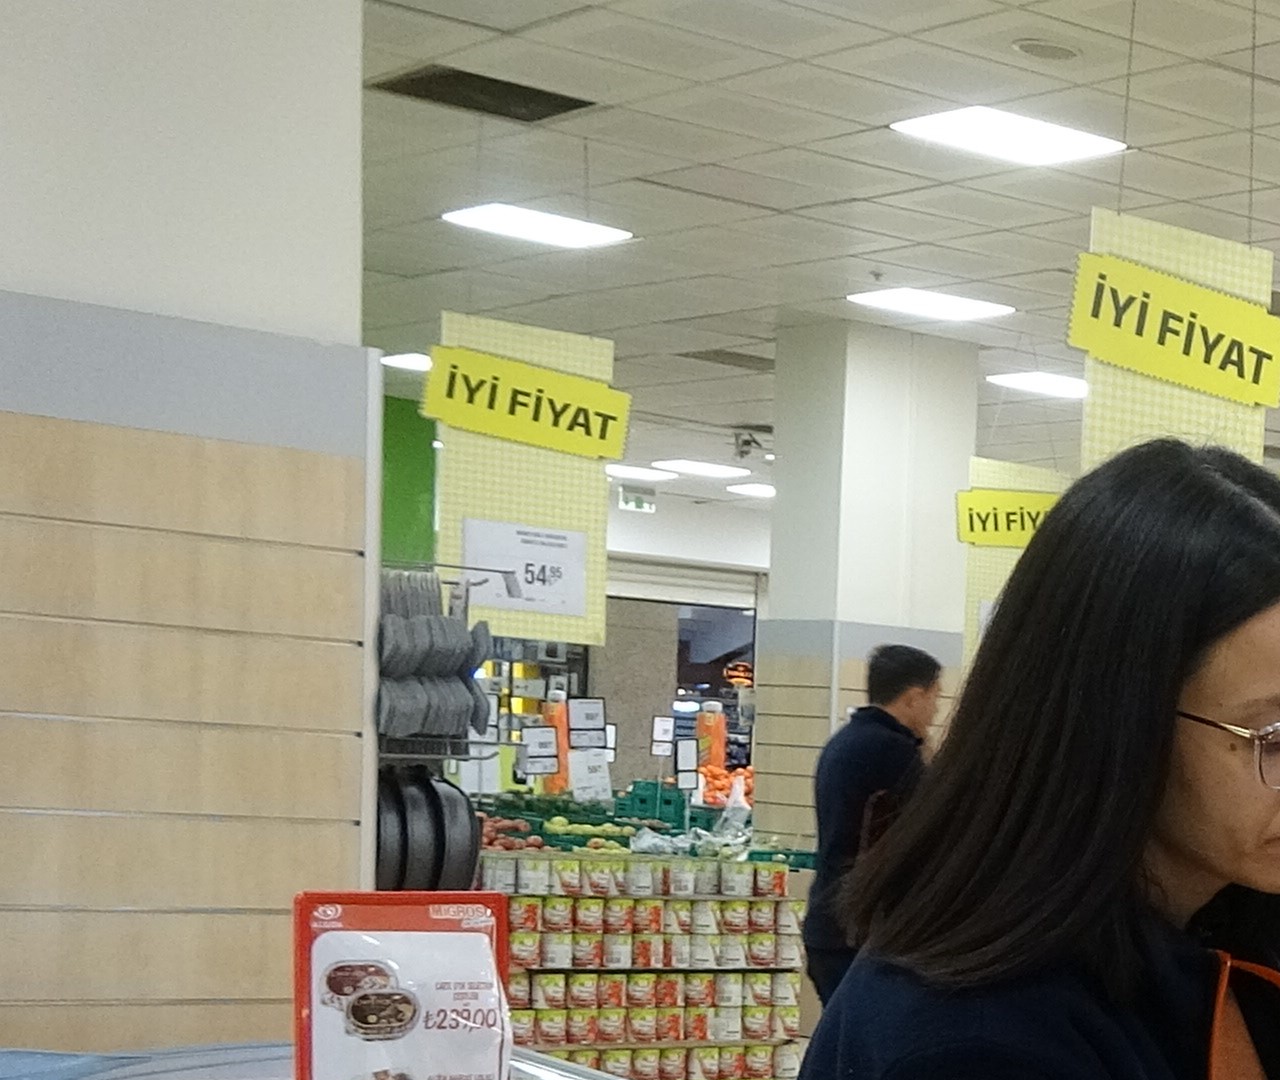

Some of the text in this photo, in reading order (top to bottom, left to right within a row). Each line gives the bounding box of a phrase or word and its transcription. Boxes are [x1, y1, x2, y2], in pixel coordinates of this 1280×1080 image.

[1090, 272, 1273, 385] İYİ FİYAT
[446, 364, 618, 440] İYİ FİYAT
[968, 507, 1048, 532] İYİ FİY
